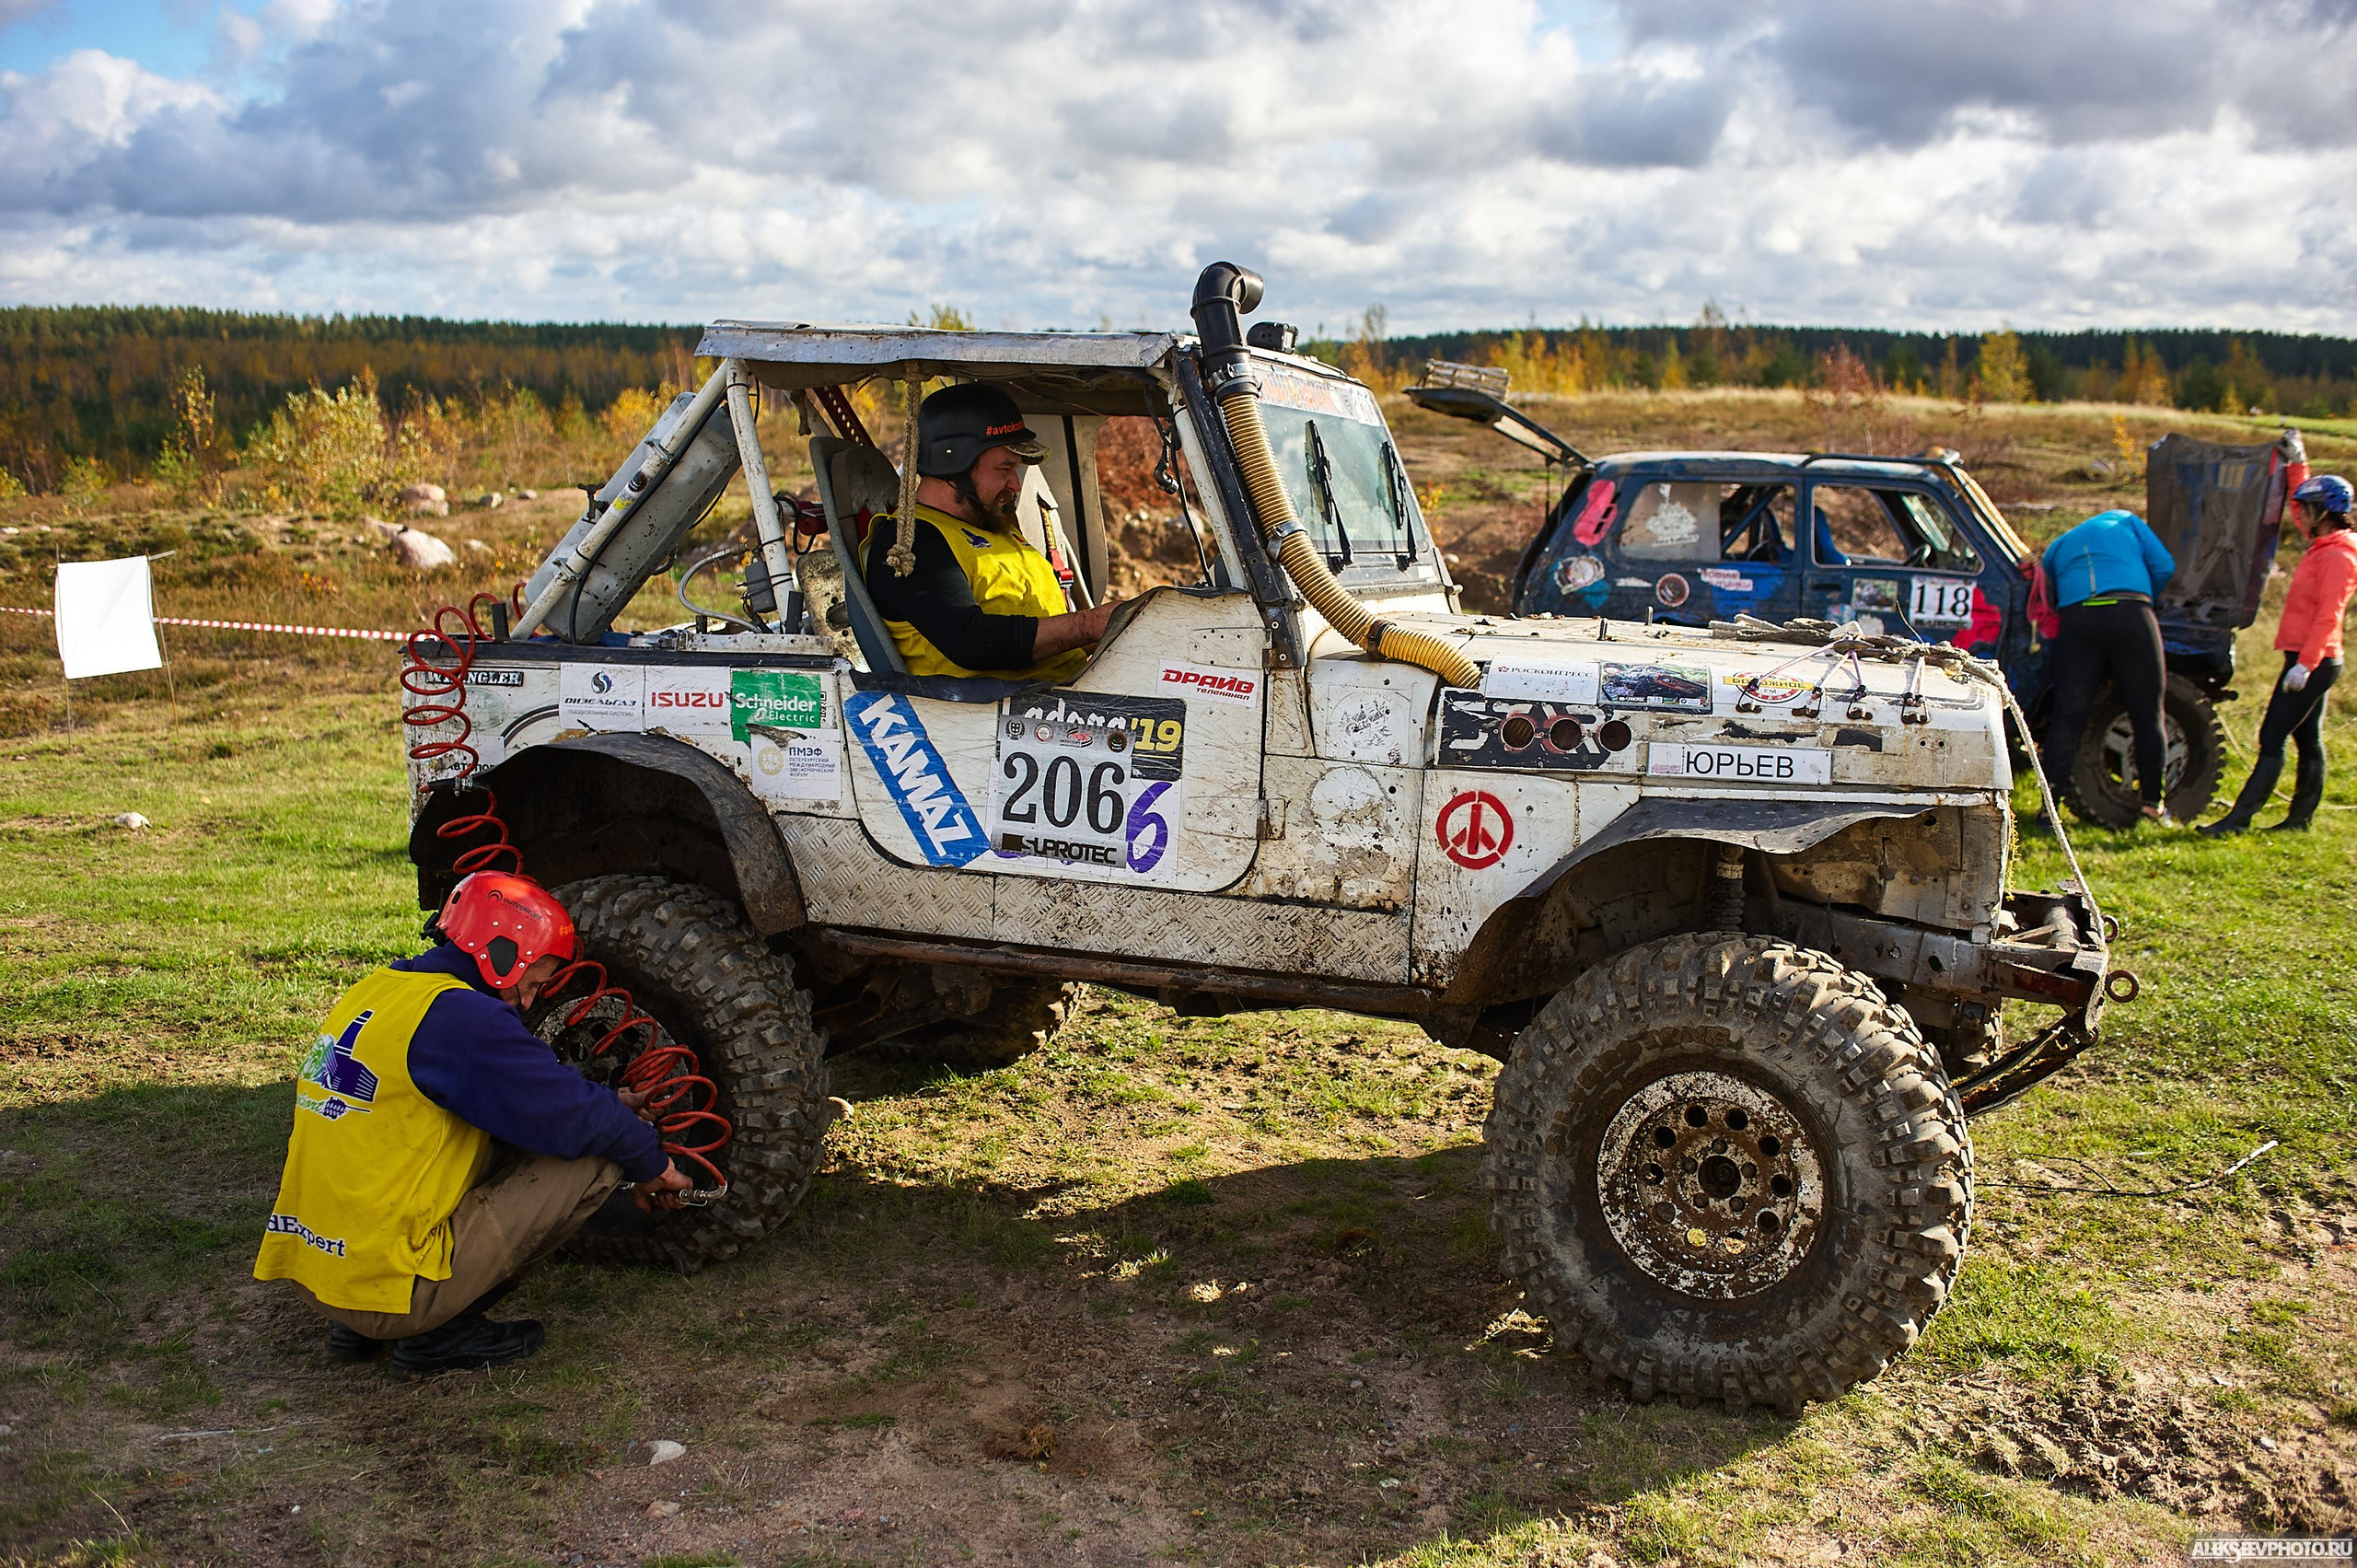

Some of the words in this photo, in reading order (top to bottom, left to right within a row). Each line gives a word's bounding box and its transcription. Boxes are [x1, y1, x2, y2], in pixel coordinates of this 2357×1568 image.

[1915, 585, 1969, 618] 118
[1161, 668, 1255, 694] ДРАЙВ
[1511, 667, 1594, 679] РОСКОНГРЕСС
[563, 697, 637, 707] ДИЗЕЛЬГАЗ
[651, 691, 724, 708] ISUZU
[735, 692, 818, 712] Schneider
[769, 711, 816, 723] Electric
[789, 747, 823, 757] ПМЭФ
[858, 693, 973, 857] KAMAZ
[1686, 750, 1794, 778] ЮРЬЕВ
[1002, 751, 1125, 834] 206
[1016, 833, 1118, 865] SUPROTEC
